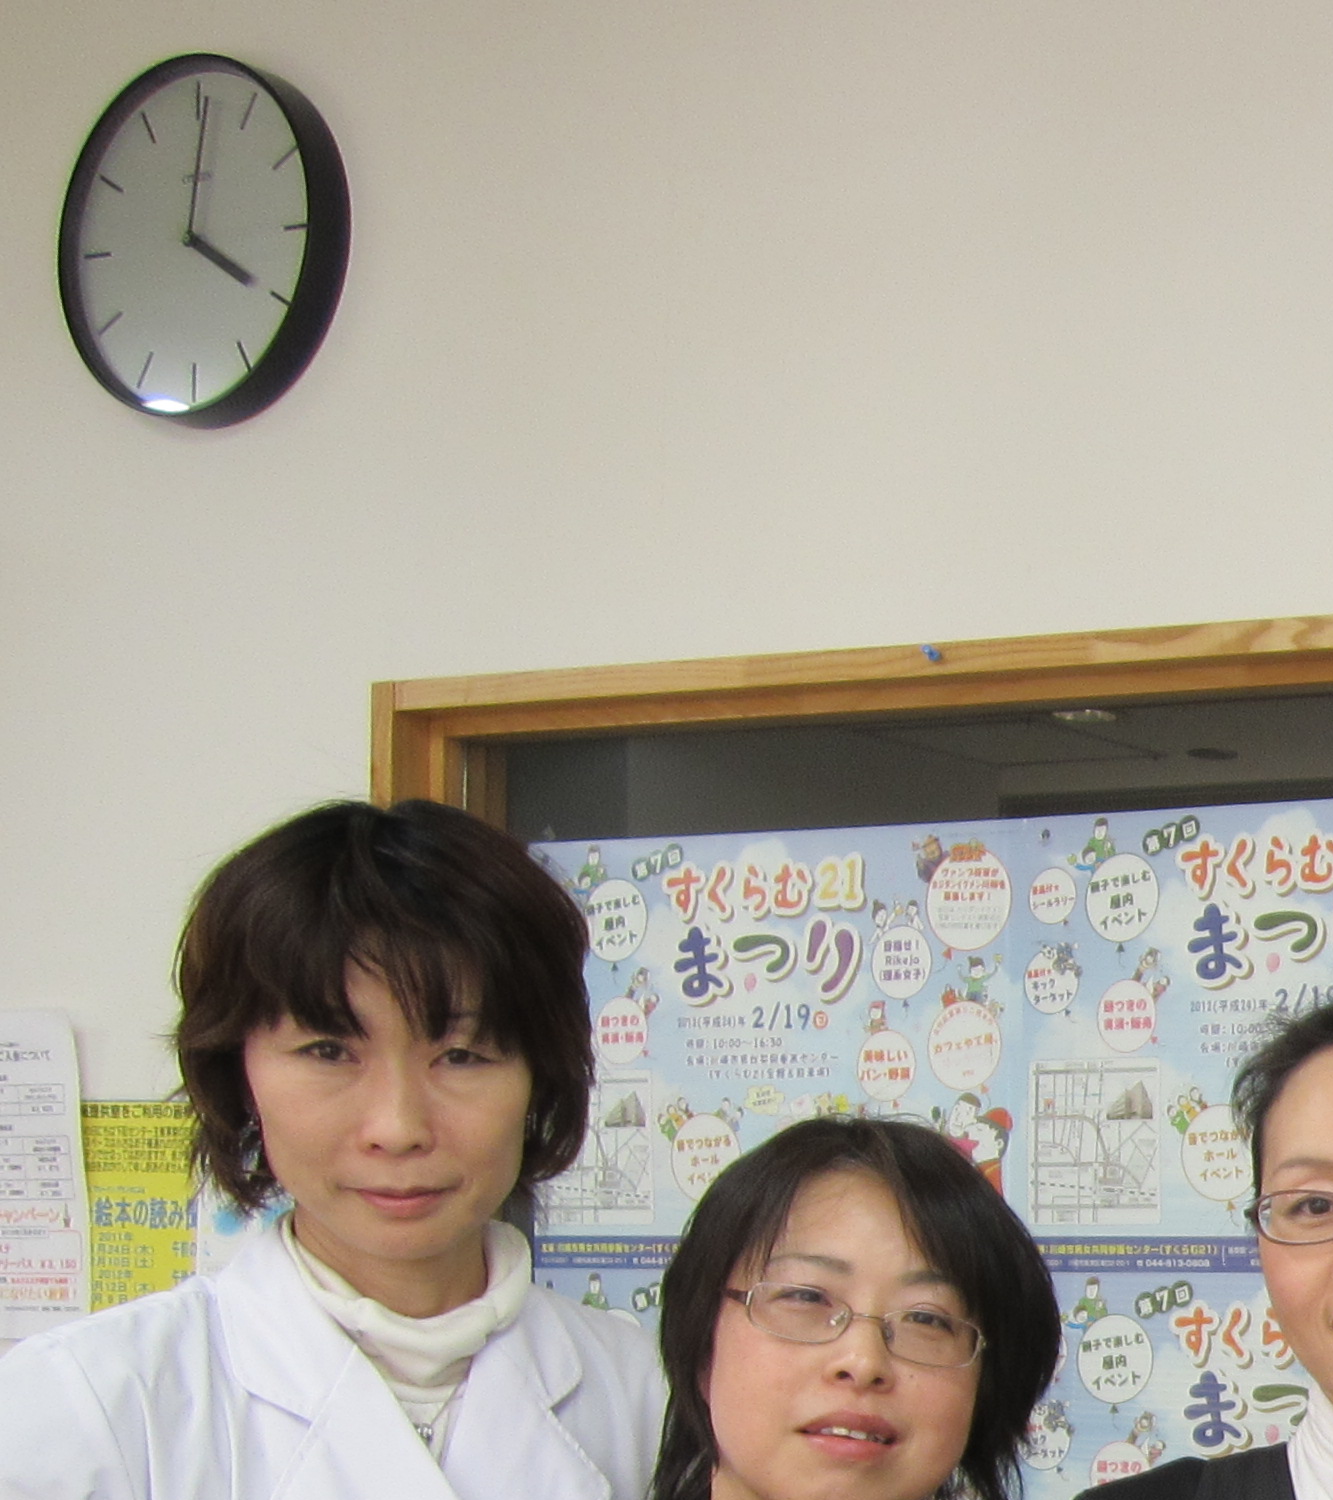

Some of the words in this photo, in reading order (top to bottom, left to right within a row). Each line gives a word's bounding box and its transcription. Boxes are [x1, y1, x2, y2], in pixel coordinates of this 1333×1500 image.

[665, 857, 858, 914] すくらむ21
[1100, 909, 1147, 930] イベント
[595, 931, 638, 951] イベント
[674, 919, 855, 998] まつり
[752, 1002, 811, 1031] 2/19
[1203, 1148, 1237, 1162] ホール
[1199, 1167, 1244, 1182] イベント
[1092, 1373, 1141, 1390] イベント
